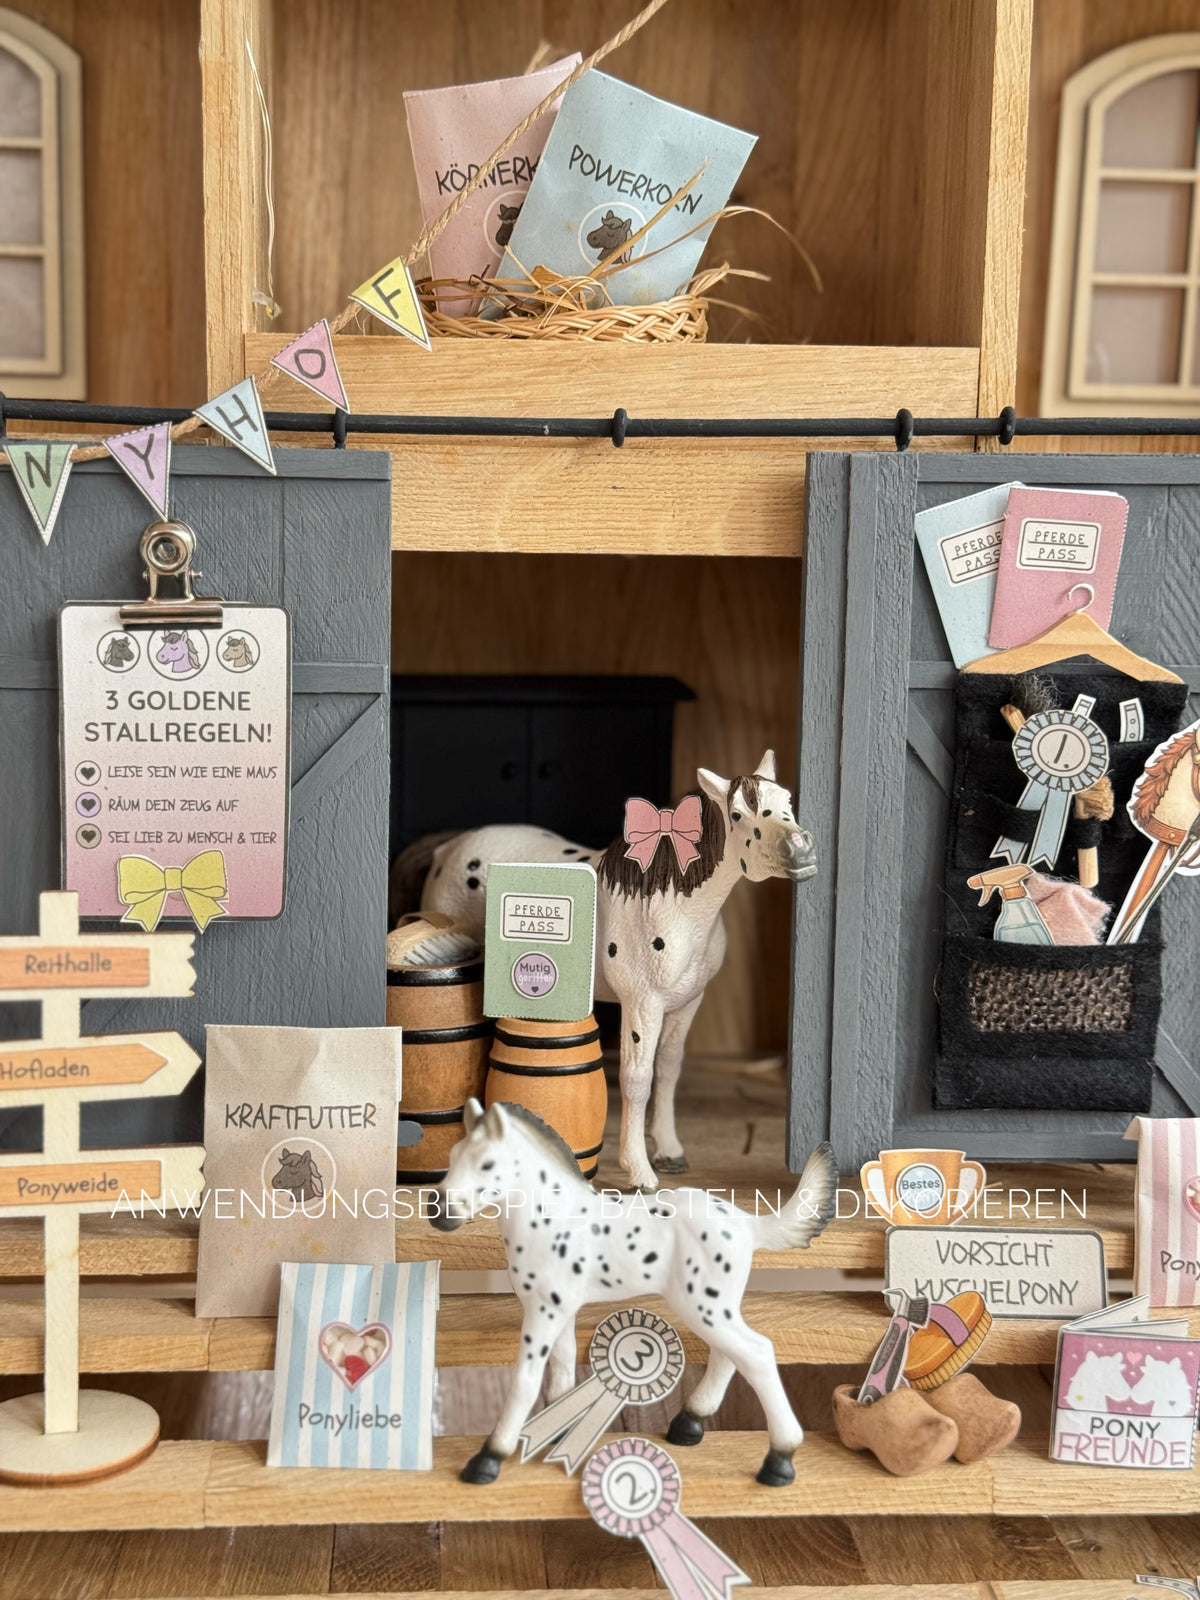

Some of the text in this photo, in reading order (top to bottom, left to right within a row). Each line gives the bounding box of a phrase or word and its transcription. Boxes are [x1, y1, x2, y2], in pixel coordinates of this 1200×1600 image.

[954, 531, 1002, 556] PFERDE
[1034, 530, 1085, 545] PFERDE
[965, 550, 1000, 571] PASS
[1038, 547, 1076, 561] PASS
[105, 690, 251, 711] 3 GOLDENE
[84, 722, 272, 743] STALLREGELN!
[108, 765, 278, 779] LEISE SEIN WIE EINE MAUS
[108, 795, 239, 812] RÄUM DEIN ZEUG AUF
[108, 831, 277, 844] SEI LIEB ZU MENSCH & TIER
[514, 904, 561, 917] PFERDE
[519, 920, 555, 932] PASS
[24, 952, 112, 975] Reithalle
[519, 963, 551, 975] Mutig
[0, 1057, 90, 1081] Hofladen
[224, 1103, 377, 1131] KRAFTFUTTER
[17, 1171, 119, 1201] Ponyweide
[901, 1179, 941, 1190] Bestes
[935, 1236, 1053, 1267] VORSICHT
[298, 1403, 402, 1437] Ponyliebe
[1090, 1416, 1161, 1439] PONY
[1056, 1431, 1187, 1466] FREUNDE
